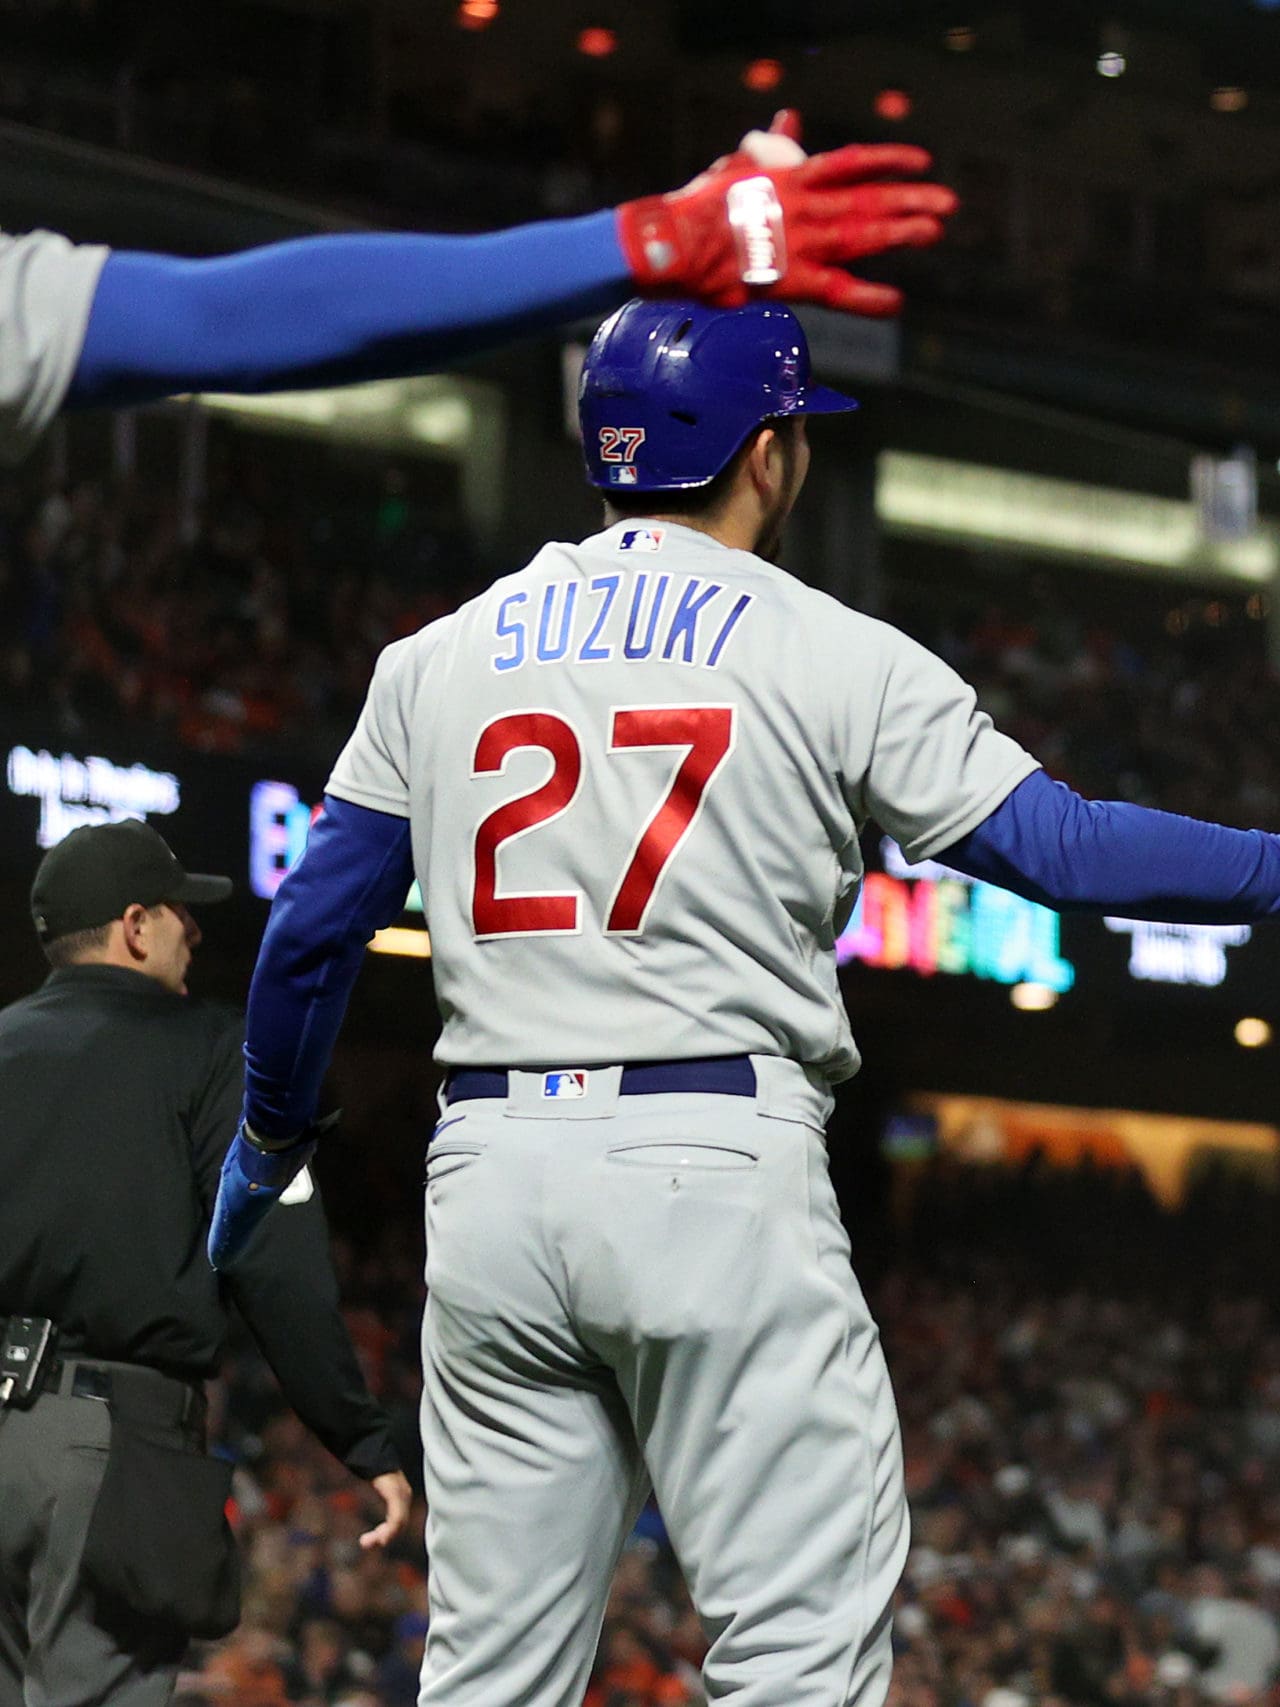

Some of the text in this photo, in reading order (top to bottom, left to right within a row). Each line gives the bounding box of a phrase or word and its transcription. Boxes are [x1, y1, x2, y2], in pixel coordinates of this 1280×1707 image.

[599, 427, 646, 462] 27
[490, 571, 755, 675] SUZUKI
[469, 703, 738, 942] 27
